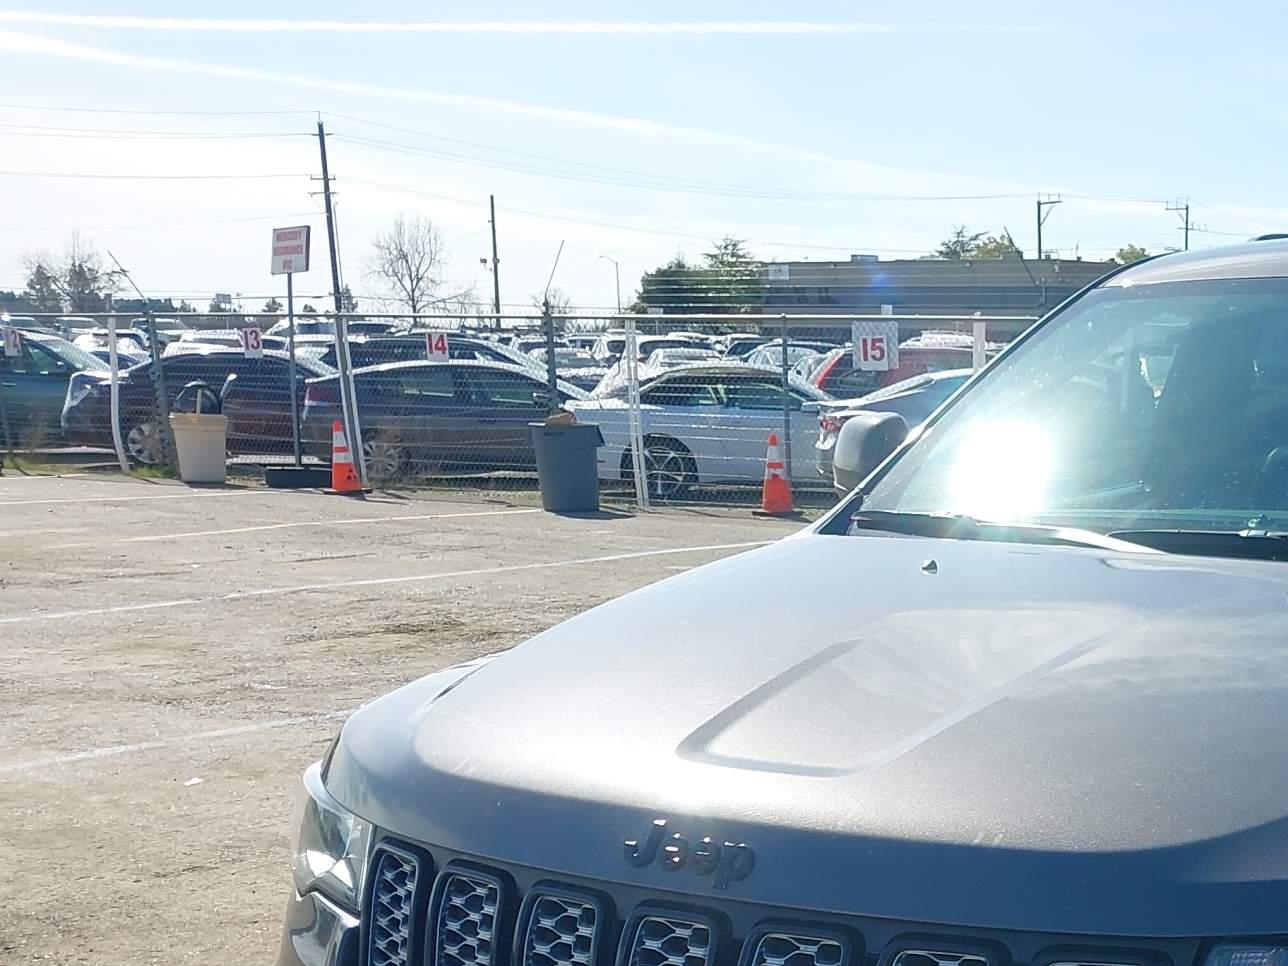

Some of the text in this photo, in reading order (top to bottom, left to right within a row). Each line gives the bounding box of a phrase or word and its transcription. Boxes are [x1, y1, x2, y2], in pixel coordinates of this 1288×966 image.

[244, 330, 260, 350] 13
[427, 334, 447, 355] 14
[862, 337, 885, 361] 15
[623, 819, 756, 889] Jeep
